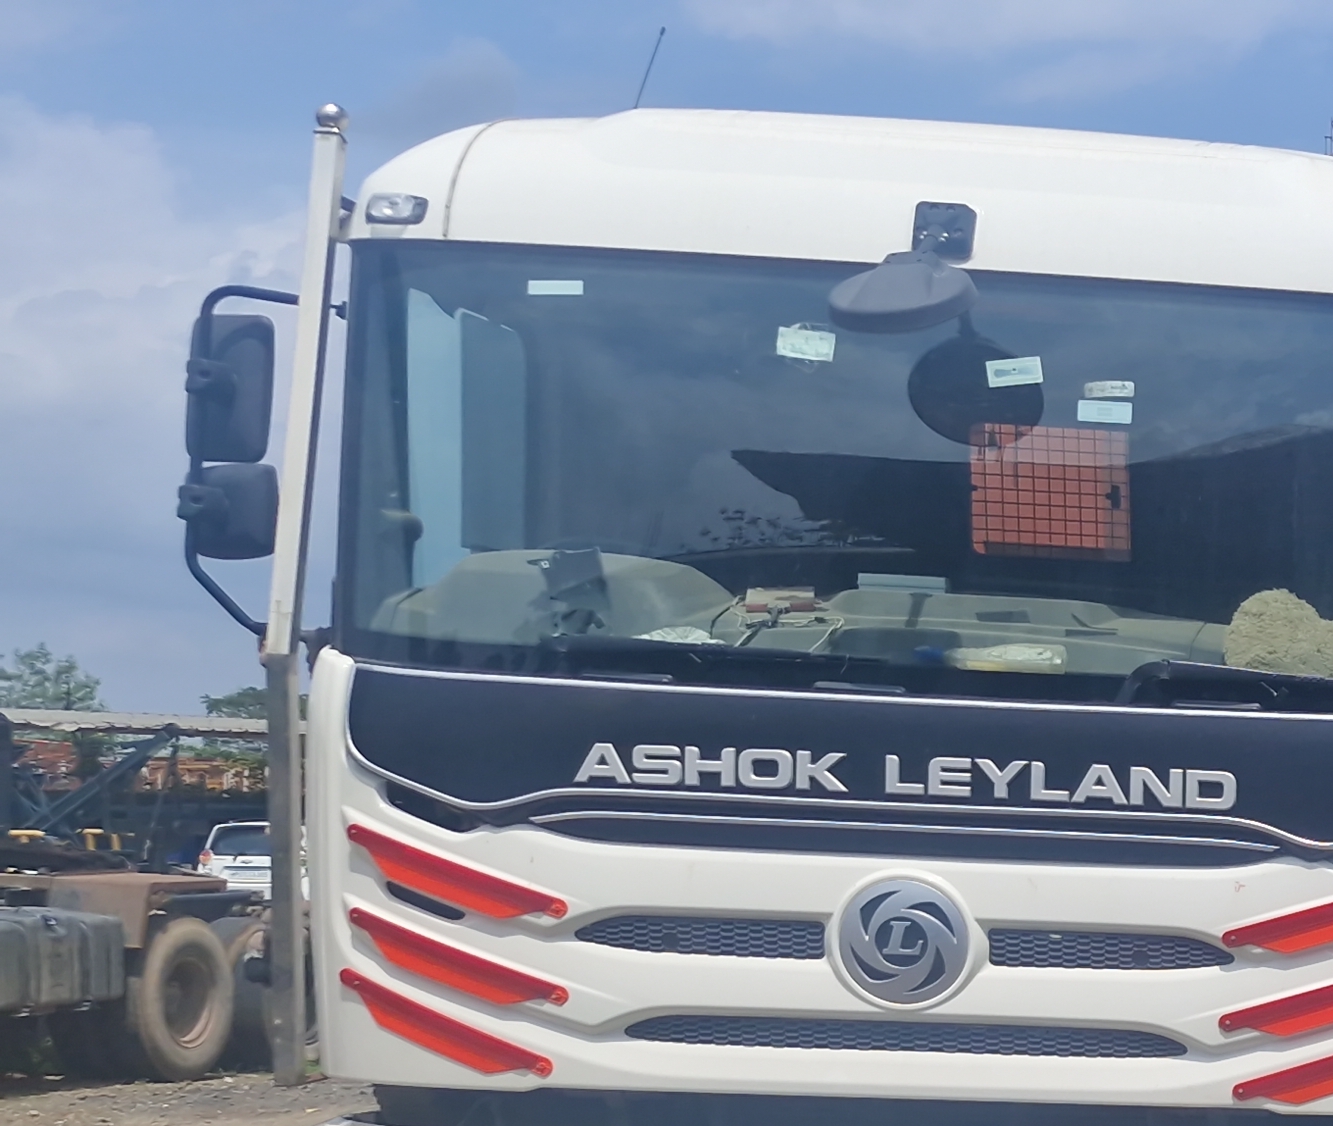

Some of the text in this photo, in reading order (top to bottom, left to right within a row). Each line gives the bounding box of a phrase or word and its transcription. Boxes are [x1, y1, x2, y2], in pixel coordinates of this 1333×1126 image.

[573, 742, 1238, 811] ASHOK LEYLAND
[882, 921, 924, 956] L
